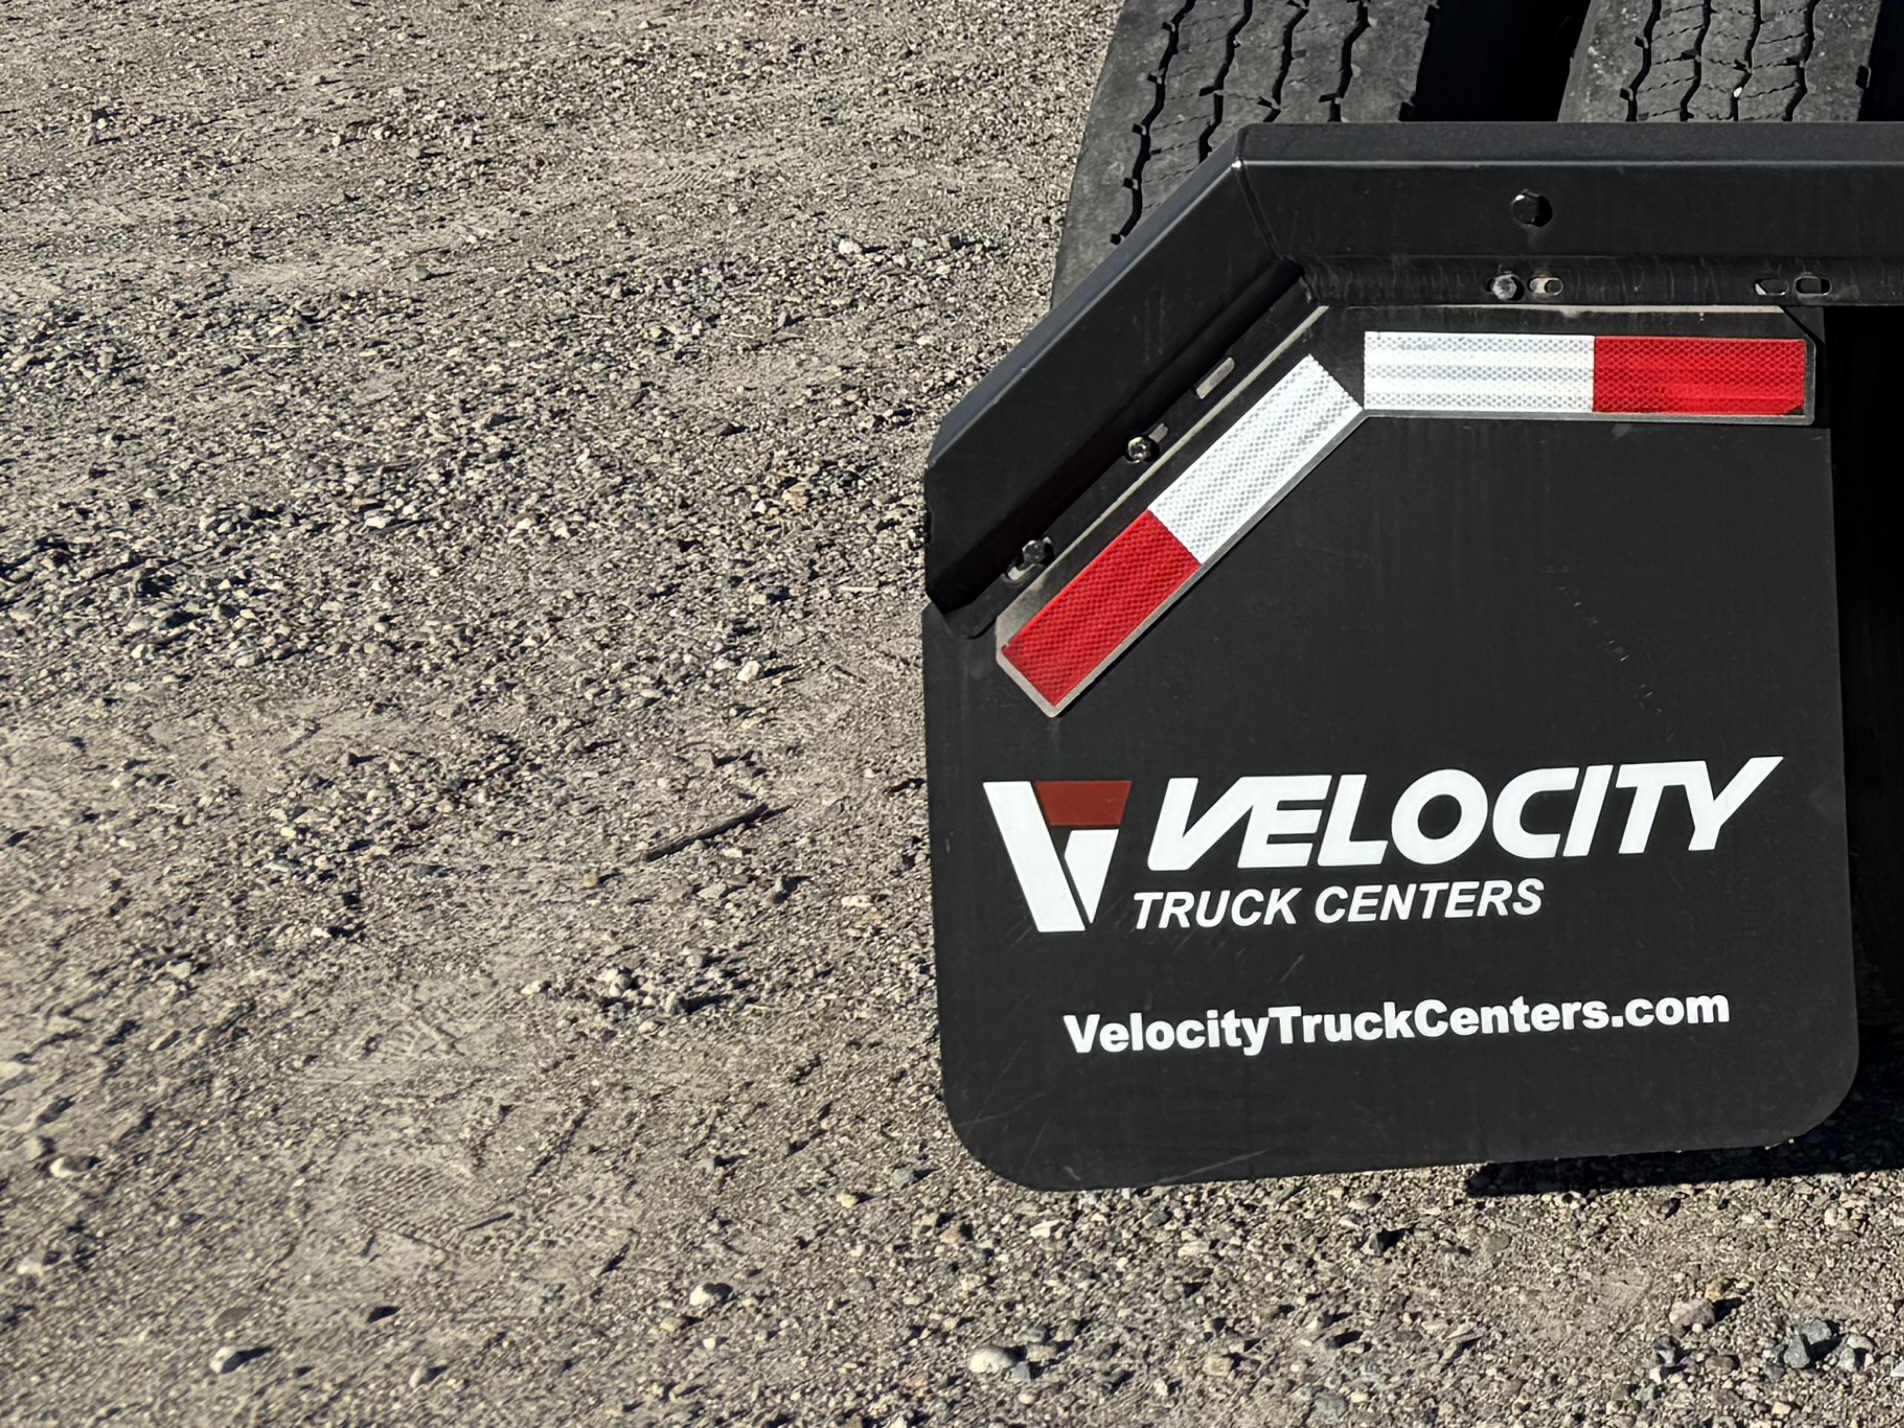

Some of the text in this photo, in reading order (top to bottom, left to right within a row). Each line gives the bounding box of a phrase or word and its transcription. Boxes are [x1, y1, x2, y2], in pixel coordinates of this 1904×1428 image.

[1147, 756, 1784, 872] VELOCITY
[1133, 877, 1546, 930] TRUCK CENTERS
[1062, 994, 1731, 1058] VelocityTruckCenters.com
